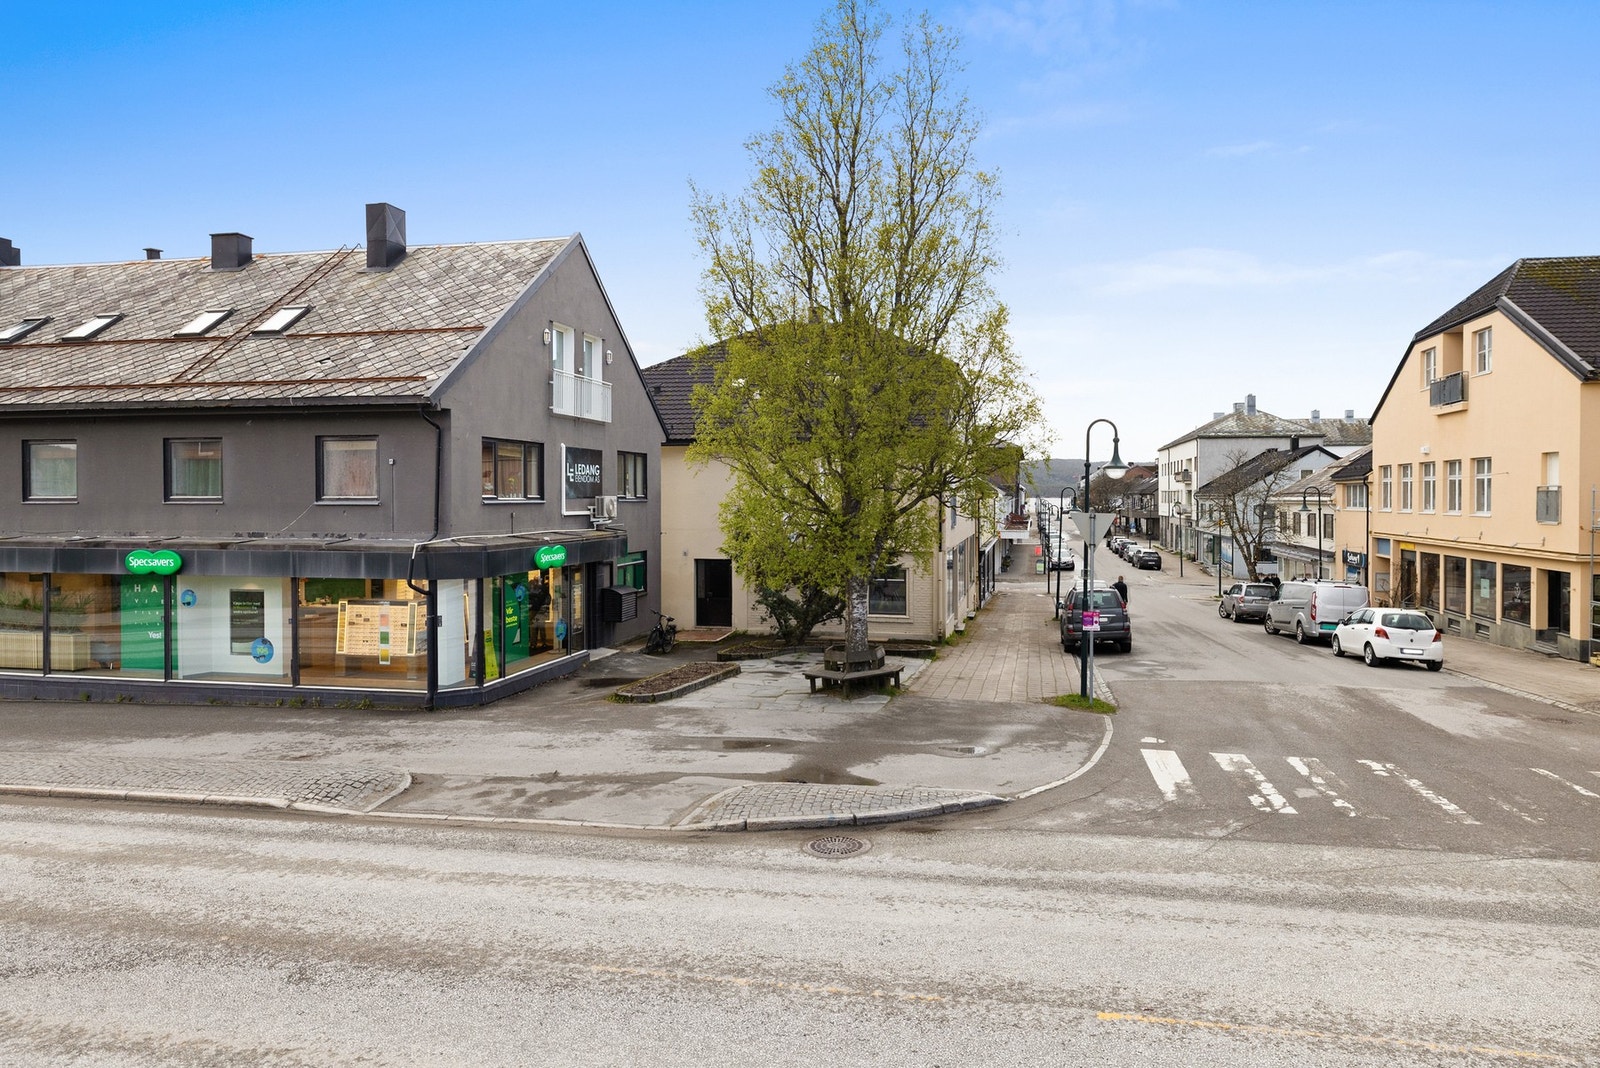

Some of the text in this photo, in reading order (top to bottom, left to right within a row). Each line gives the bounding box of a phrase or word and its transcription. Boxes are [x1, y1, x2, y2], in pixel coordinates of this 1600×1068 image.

[574, 463, 600, 476] LEDANG
[128, 556, 174, 568] Specsavers
[540, 553, 566, 564] Specsavers
